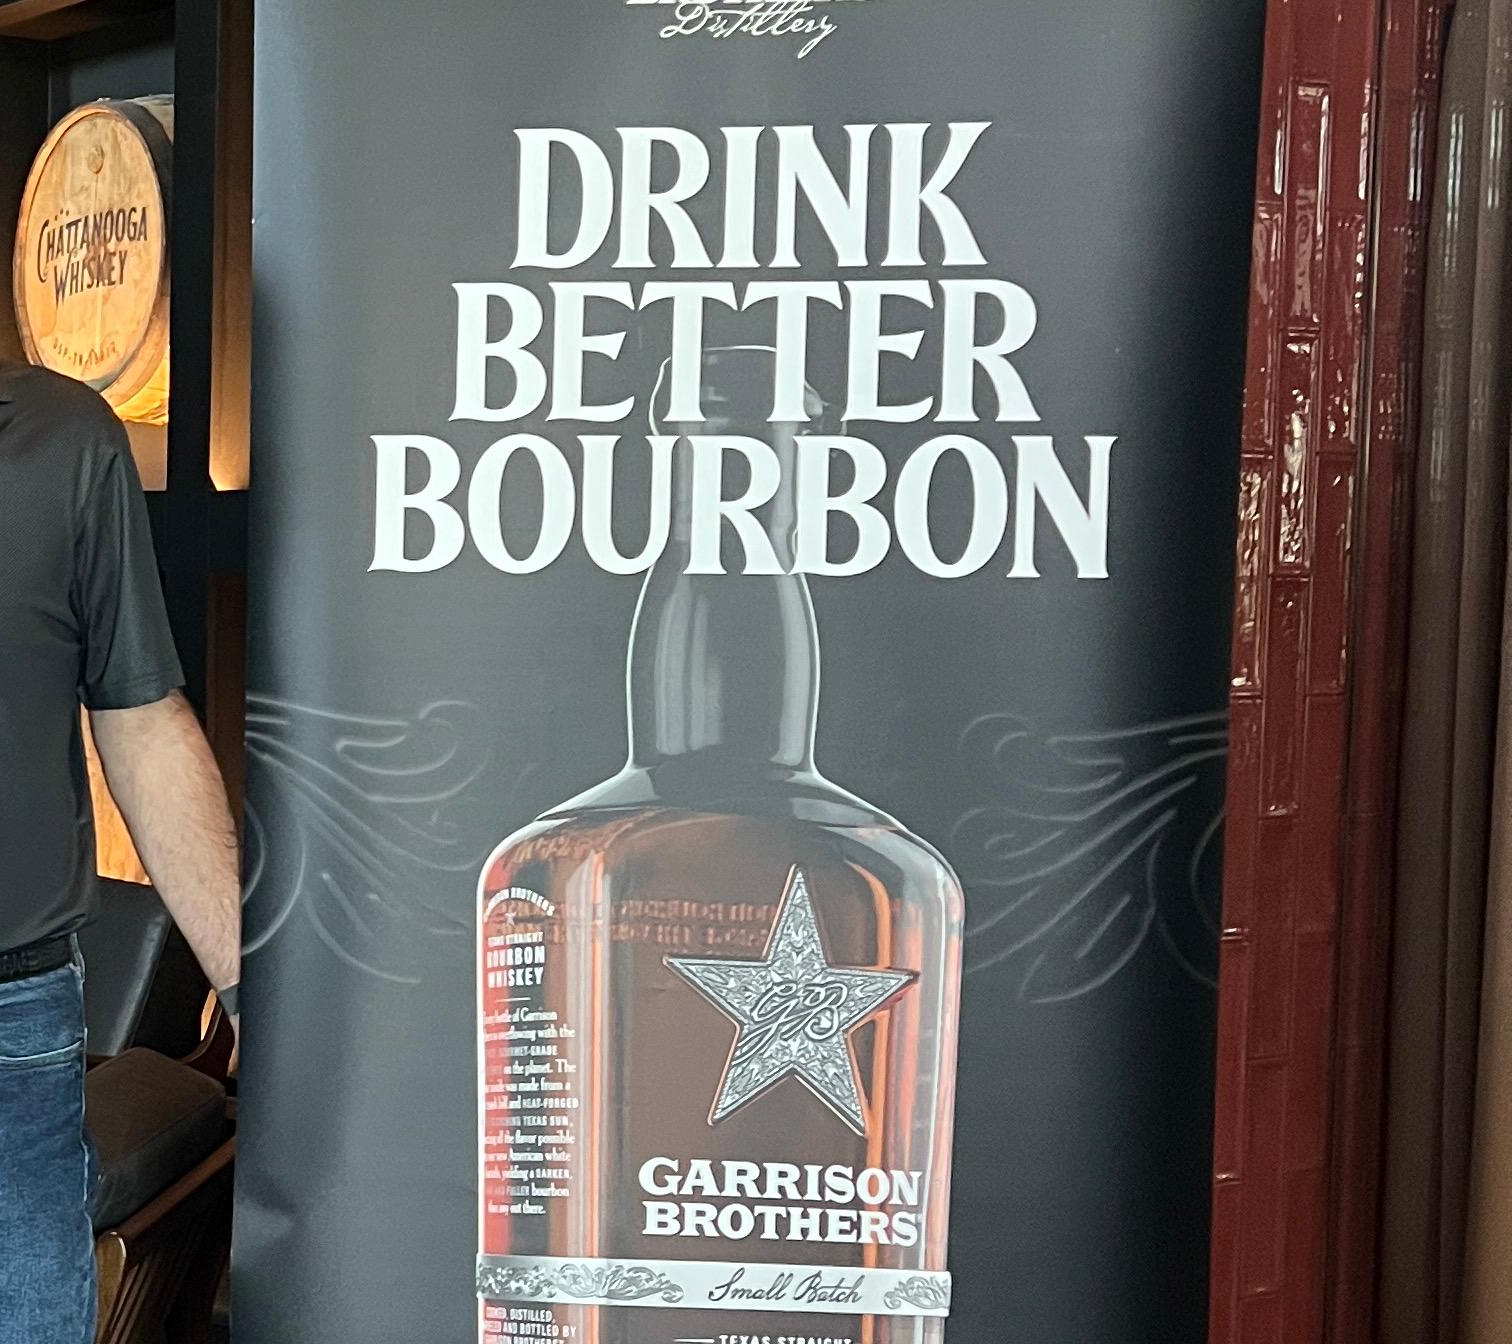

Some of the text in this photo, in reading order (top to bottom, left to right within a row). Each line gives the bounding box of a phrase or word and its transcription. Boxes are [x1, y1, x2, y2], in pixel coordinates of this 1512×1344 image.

[510, 122, 992, 269] DRINK
[38, 206, 148, 284] CHATTANOOGA
[54, 250, 128, 304] WHISKEY
[448, 279, 1041, 423] BETTER
[368, 433, 1118, 578] BOURBON
[487, 945, 545, 968] BOURBON
[488, 967, 543, 988] WHISKEY
[559, 1024, 575, 1038] the
[555, 1059, 577, 1073] The
[538, 1129, 576, 1146] possible
[545, 1147, 572, 1162] white
[531, 1182, 570, 1197] bourbon
[638, 1156, 922, 1205] GARRISON
[641, 1201, 919, 1246] BROTHERS
[708, 1267, 865, 1304] Small Batch
[519, 1323, 560, 1337] BOTTLED
[562, 1325, 577, 1338] BY
